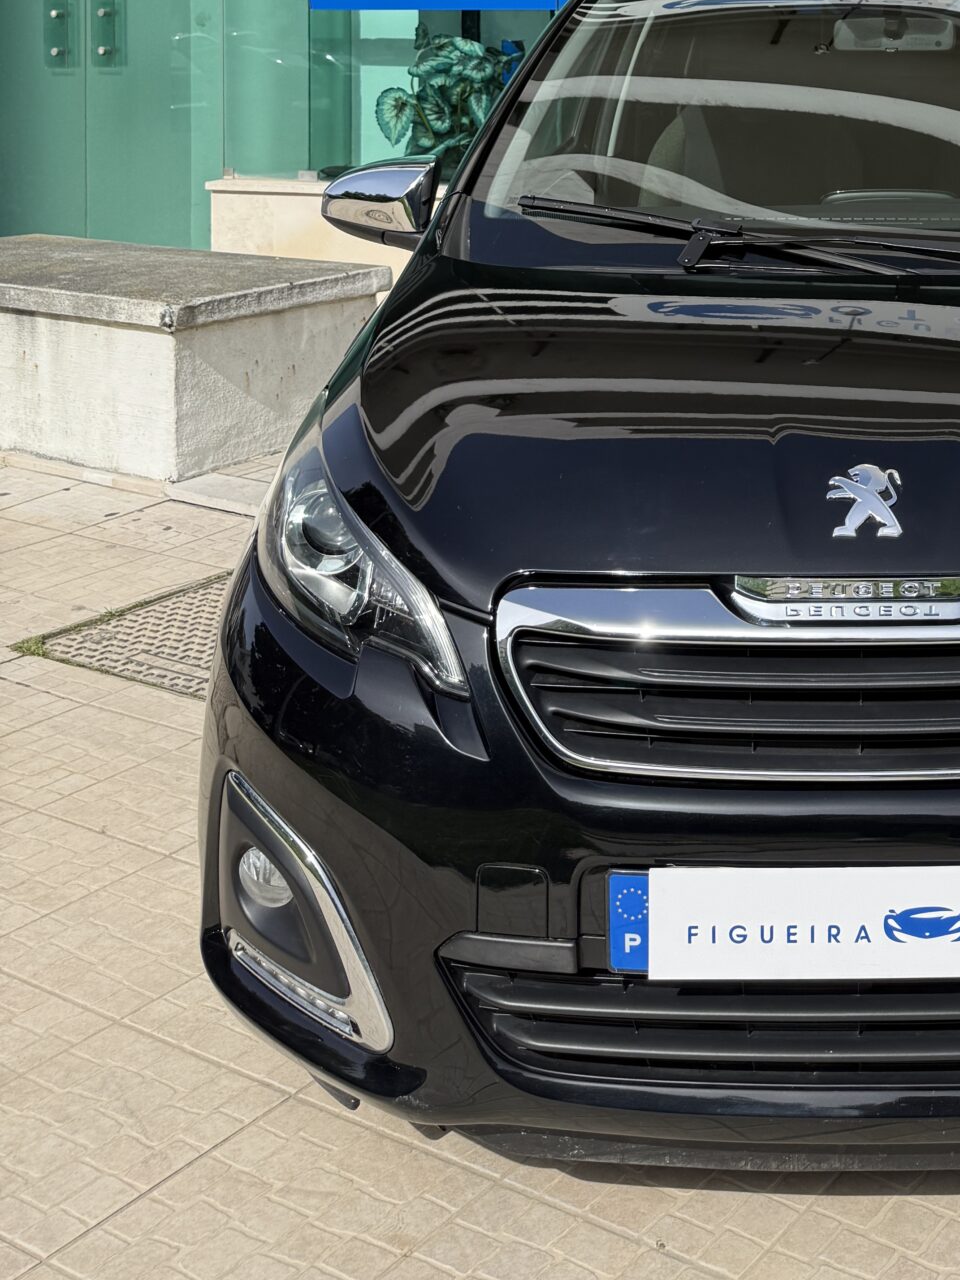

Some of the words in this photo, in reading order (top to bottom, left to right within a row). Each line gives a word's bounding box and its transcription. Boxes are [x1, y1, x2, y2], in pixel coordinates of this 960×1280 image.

[785, 581, 942, 598] PEUGEOT
[625, 933, 642, 953] P
[687, 923, 872, 944] FIGUEIRA
